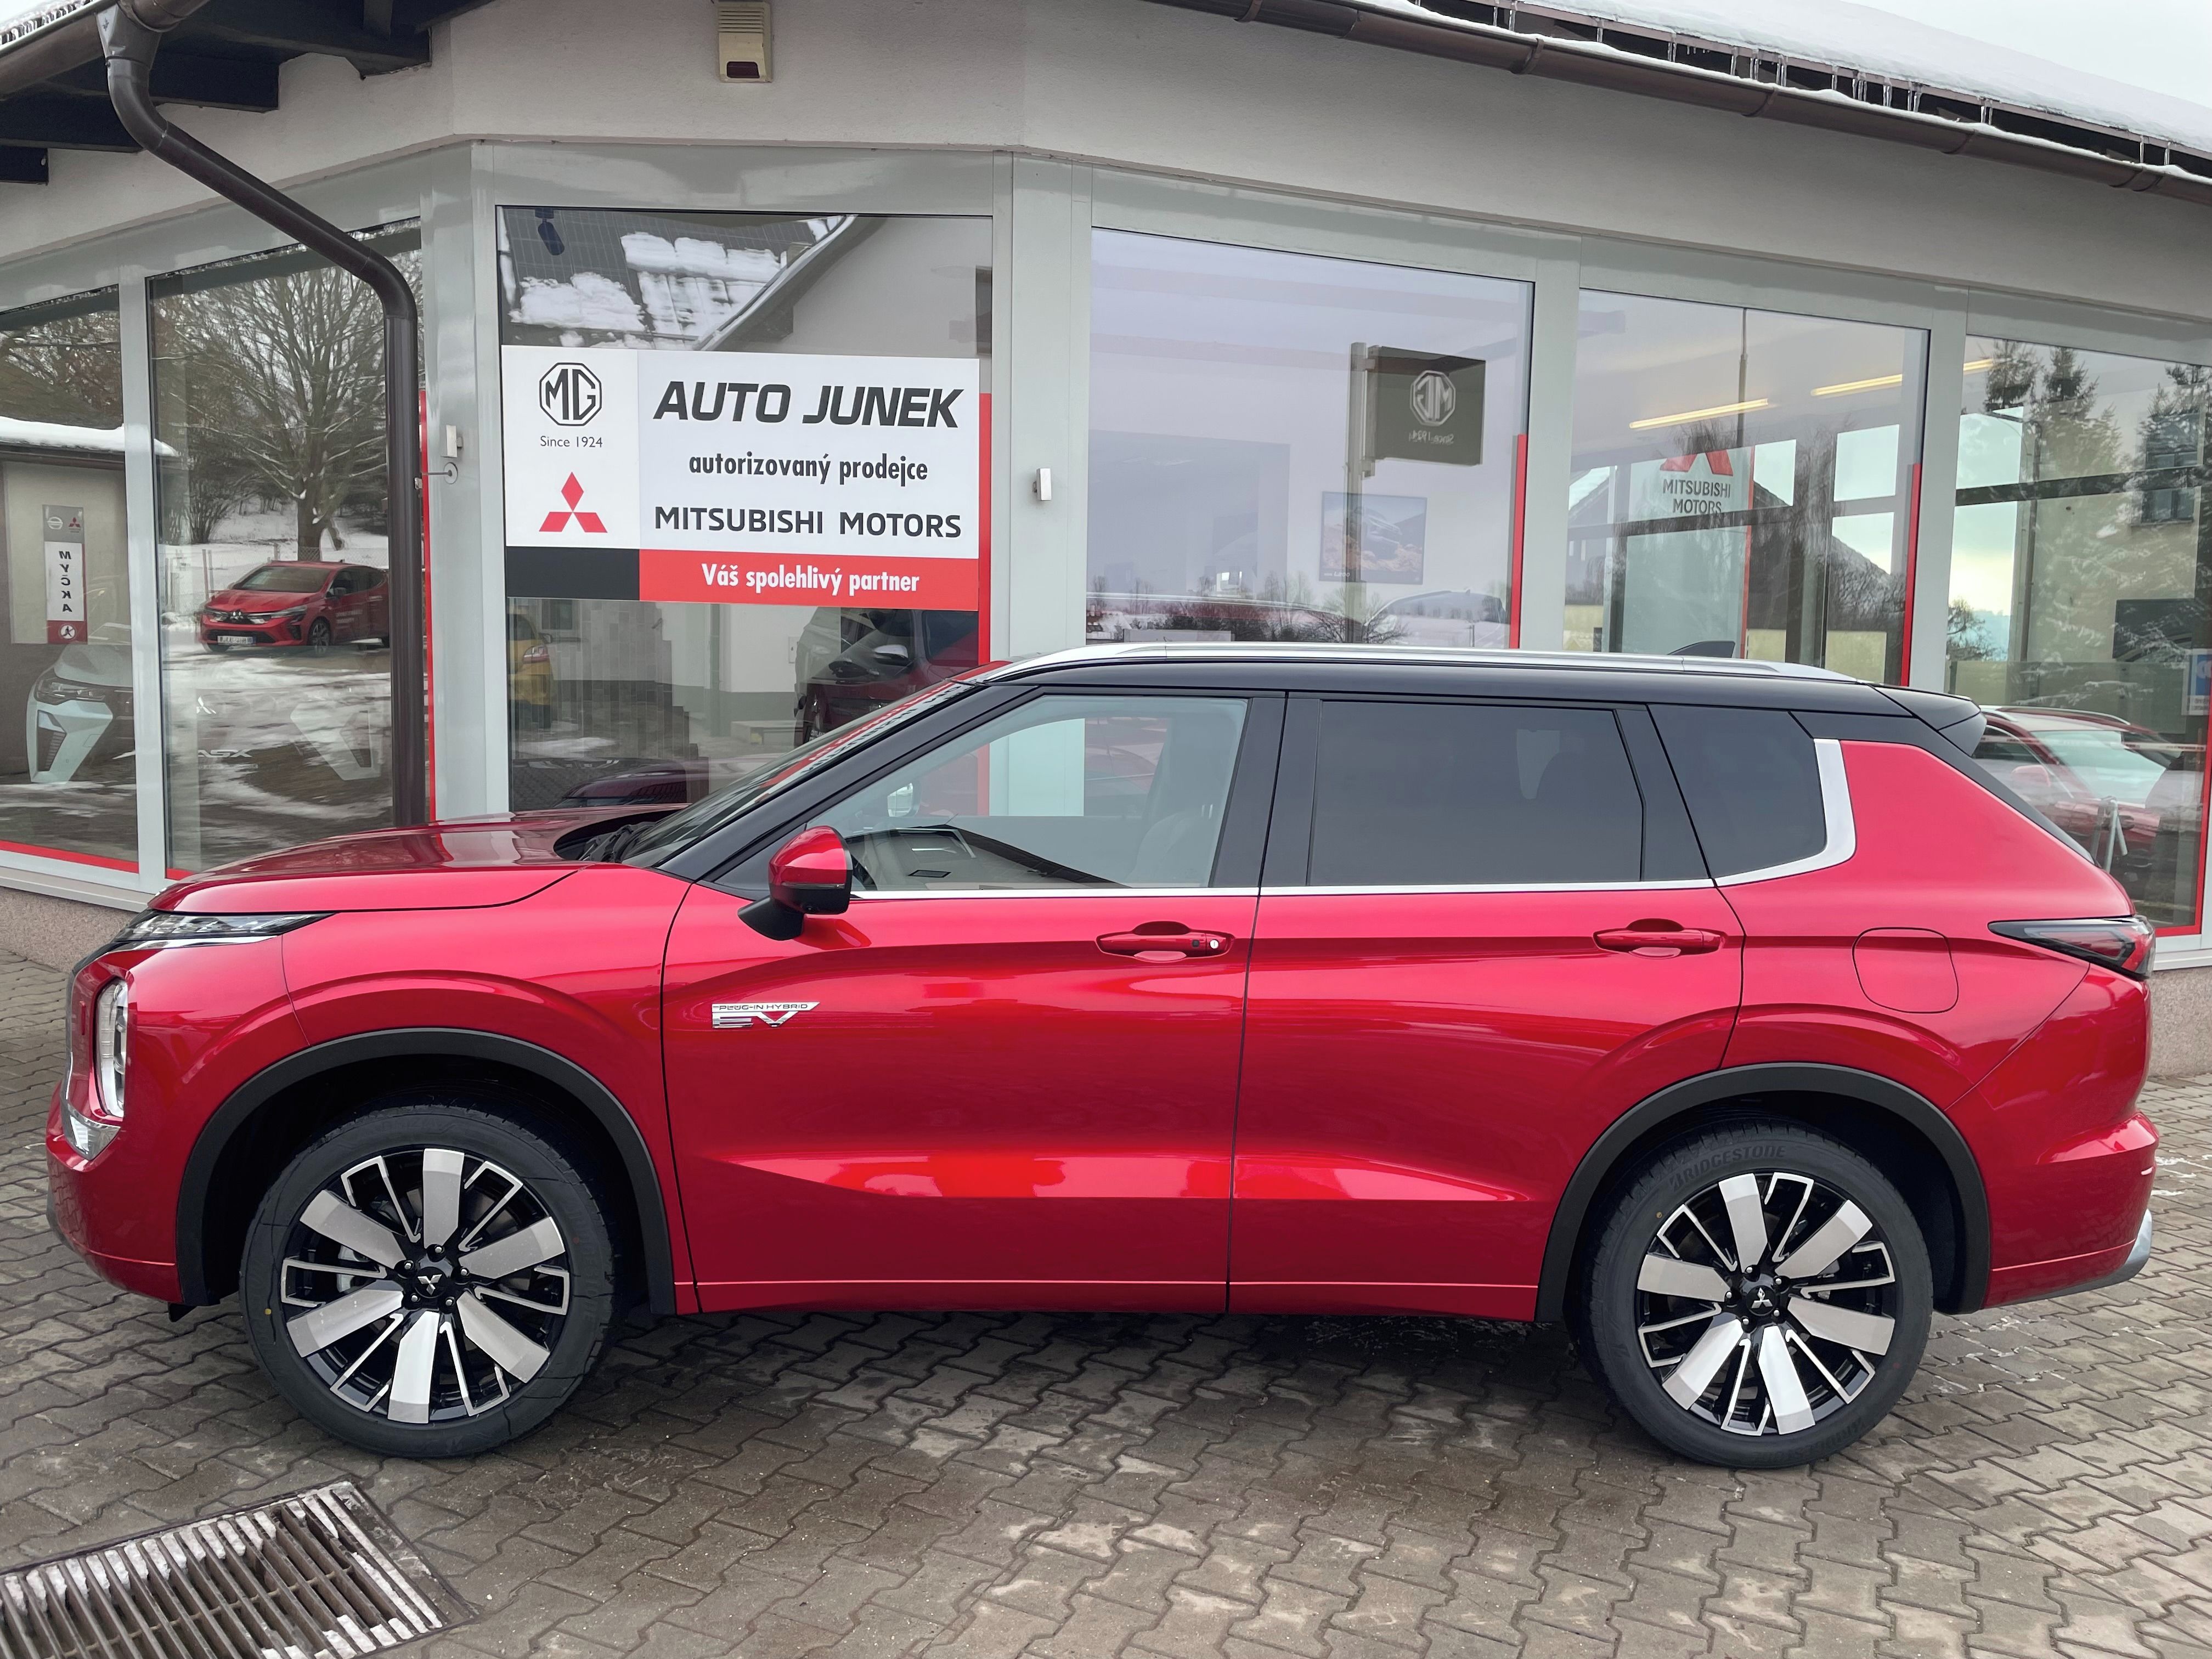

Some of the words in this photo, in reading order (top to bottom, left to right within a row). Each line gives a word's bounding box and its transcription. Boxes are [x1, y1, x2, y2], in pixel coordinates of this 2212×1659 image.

[545, 367, 598, 422] MG
[653, 381, 791, 422] AUTO
[803, 386, 964, 427] JUNEK
[540, 435, 570, 447] Since
[576, 436, 603, 448] 1924
[690, 452, 831, 484] autorizovaný
[840, 453, 928, 487] prodejce
[1663, 478, 1731, 498] MITSUBISHI
[656, 507, 823, 534] MITSUBISHI
[840, 512, 961, 538] MOTORS
[1673, 498, 1722, 514] MOTORS
[702, 563, 738, 586] Váš
[746, 565, 842, 595] spolehlivý
[849, 572, 919, 596] partner
[1670, 1145, 1786, 1189] BRIDGESTONE
